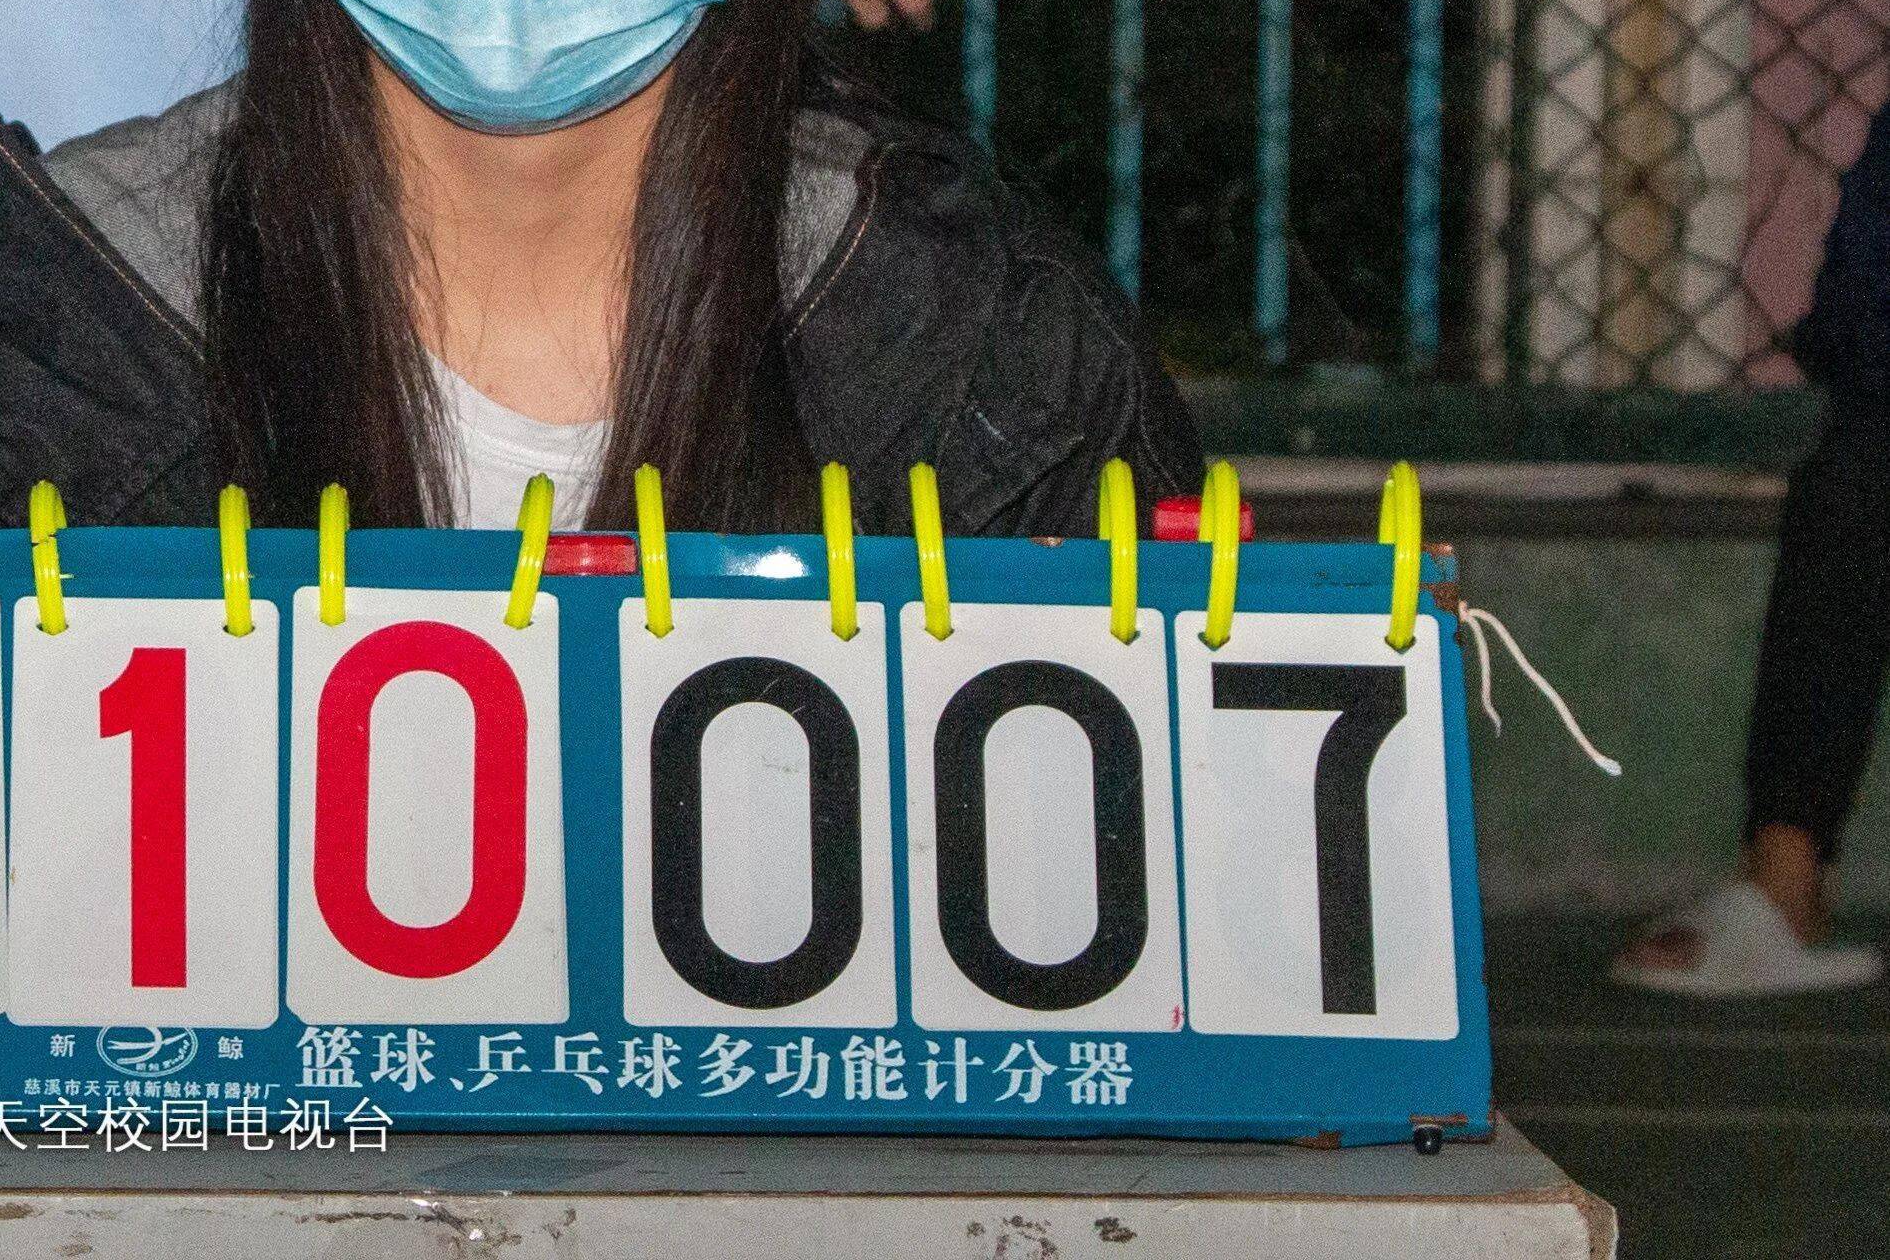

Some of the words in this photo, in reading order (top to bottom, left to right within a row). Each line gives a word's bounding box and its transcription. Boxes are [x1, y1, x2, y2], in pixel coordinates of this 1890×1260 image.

[50, 1034, 76, 1058] 新
[217, 1036, 244, 1060] 鲸
[295, 1026, 1134, 1106] 篮球、乒乓球多功能计分器
